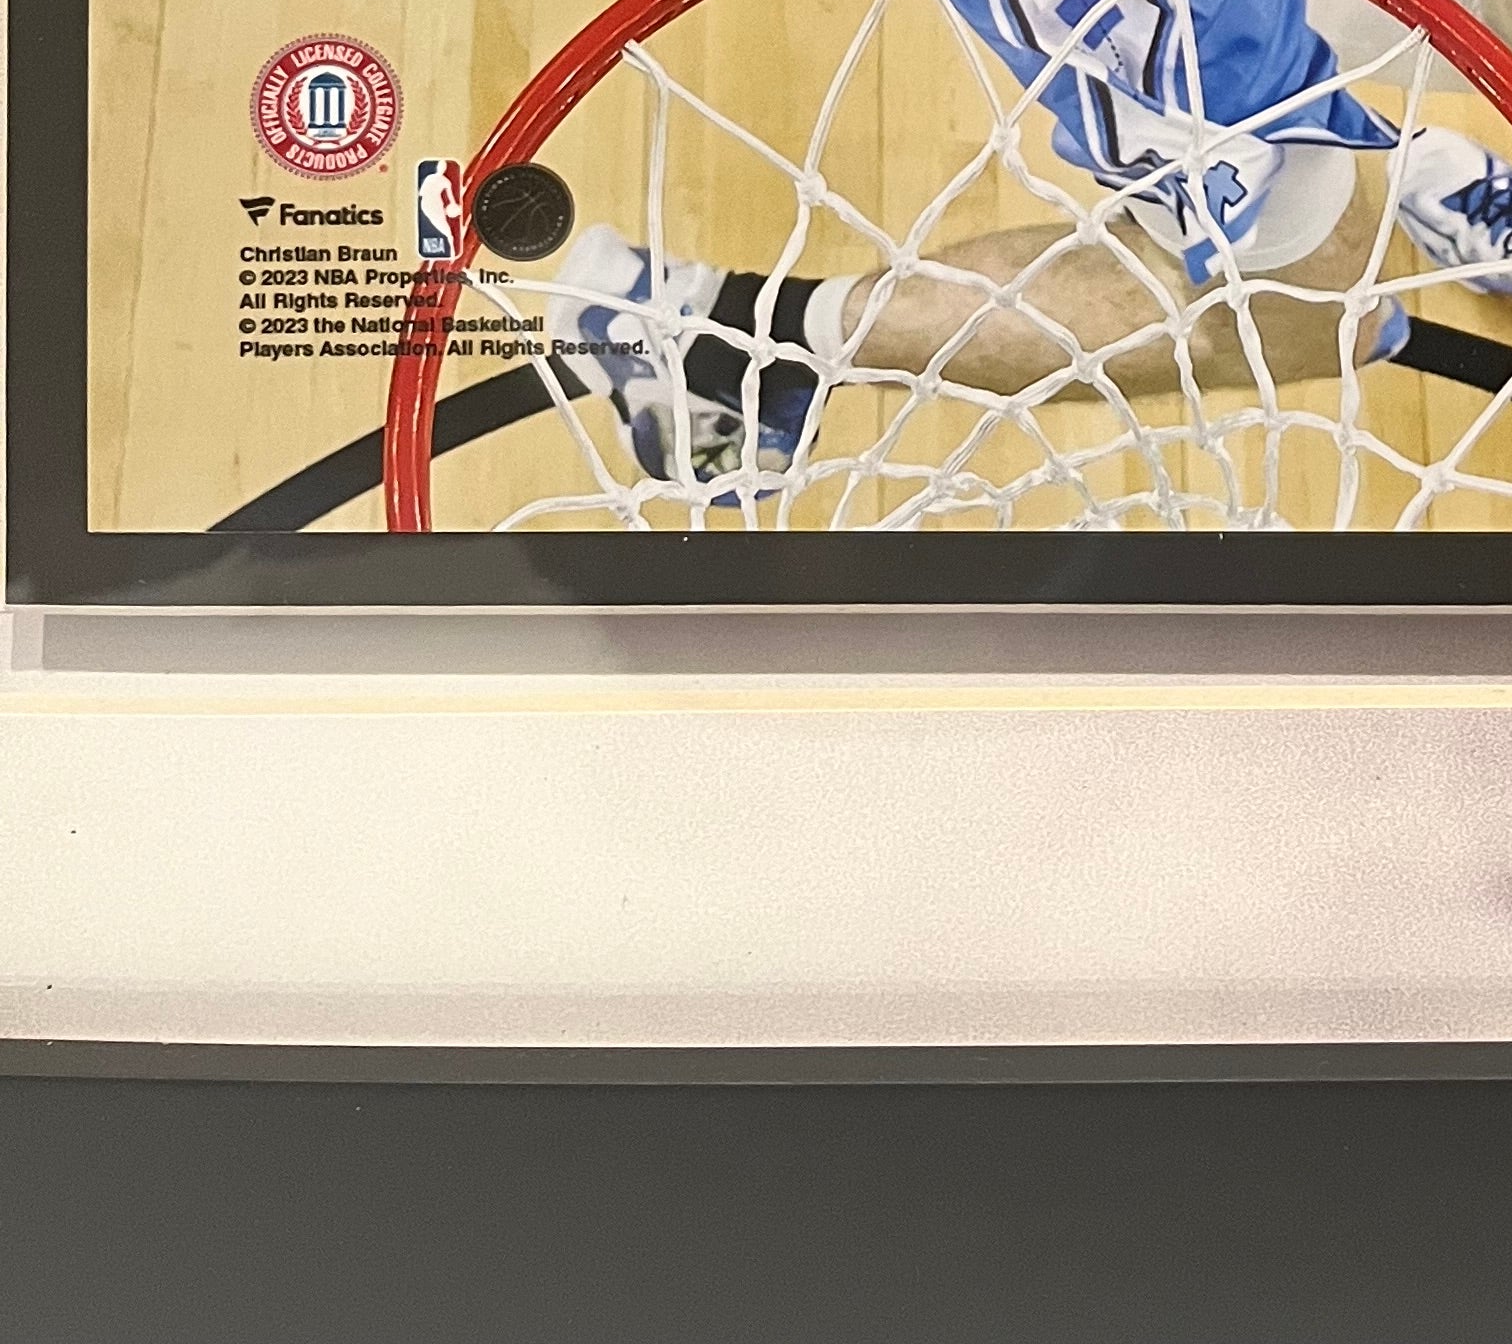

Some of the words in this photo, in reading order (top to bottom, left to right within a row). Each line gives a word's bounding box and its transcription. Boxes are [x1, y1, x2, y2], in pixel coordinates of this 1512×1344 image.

[261, 64, 290, 145] OFFICIALLY
[290, 43, 364, 69] LICENSED
[361, 63, 394, 147] COLLEGIATE
[285, 143, 369, 171] PRODUCTS
[280, 203, 384, 226] Fanatics
[239, 246, 331, 262] Christian
[338, 246, 398, 262] Braun
[422, 237, 446, 254] NBA
[261, 269, 308, 286] 2023
[314, 269, 359, 286] NBA
[365, 269, 473, 289] Properties,
[479, 268, 515, 285] Inc.
[239, 293, 267, 310] All
[273, 293, 339, 313] Rights
[344, 292, 443, 309] Reserved.
[261, 318, 308, 334] 2023
[314, 318, 345, 333] the
[351, 317, 435, 334] National
[442, 316, 544, 333] Basketball
[239, 341, 314, 361] Players
[446, 340, 473, 356] All
[480, 340, 545, 359] Rights
[551, 339, 650, 357] Reserved.
